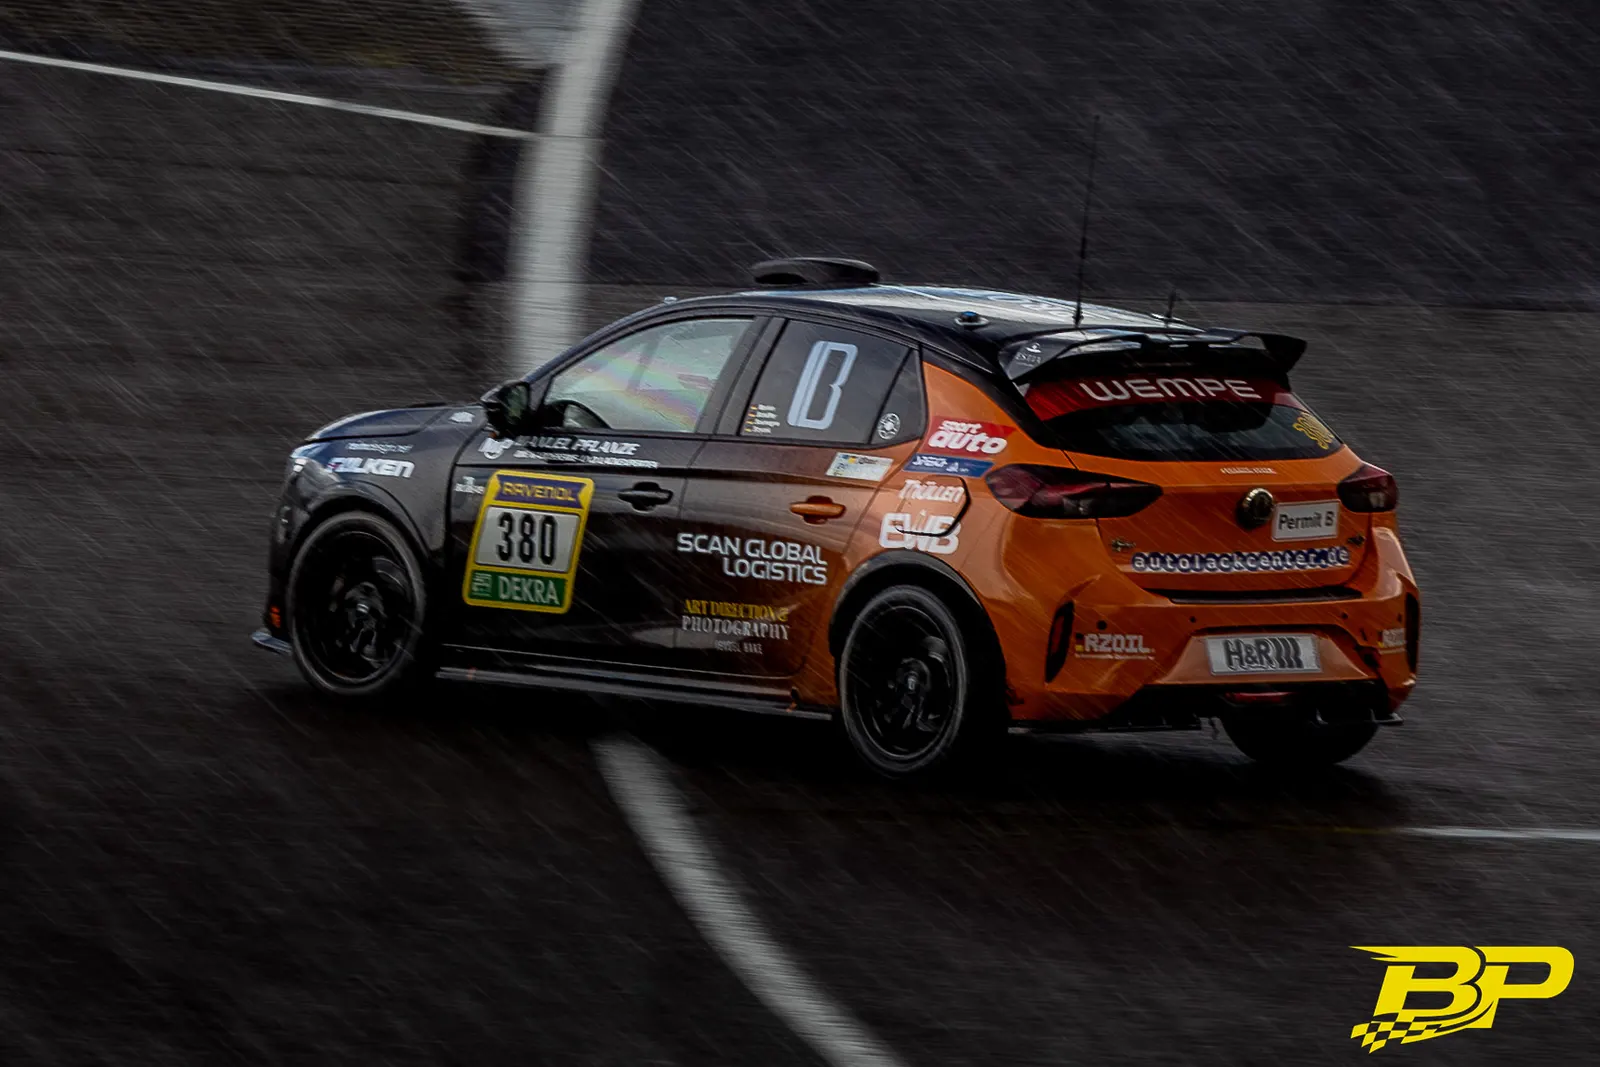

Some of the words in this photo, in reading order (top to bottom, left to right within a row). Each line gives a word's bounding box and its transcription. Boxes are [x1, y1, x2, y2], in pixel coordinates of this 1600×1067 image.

[1079, 378, 1262, 400] WEMPE
[928, 431, 1008, 454] auto
[326, 456, 415, 479] FALKEN
[502, 481, 577, 502] RAVENOL
[1278, 512, 1322, 530] Permit
[1324, 512, 1335, 526] B
[497, 511, 556, 565] 380
[676, 532, 742, 557] SCAN
[744, 538, 828, 566] GLOBAL
[722, 557, 829, 586] LOGISTICS
[1131, 548, 1350, 572] autolackcenter.de
[497, 575, 560, 605] DEKRA
[683, 599, 709, 615] ART
[709, 601, 776, 621] DIRECTION
[681, 614, 790, 640] PHOTOGRAPHY
